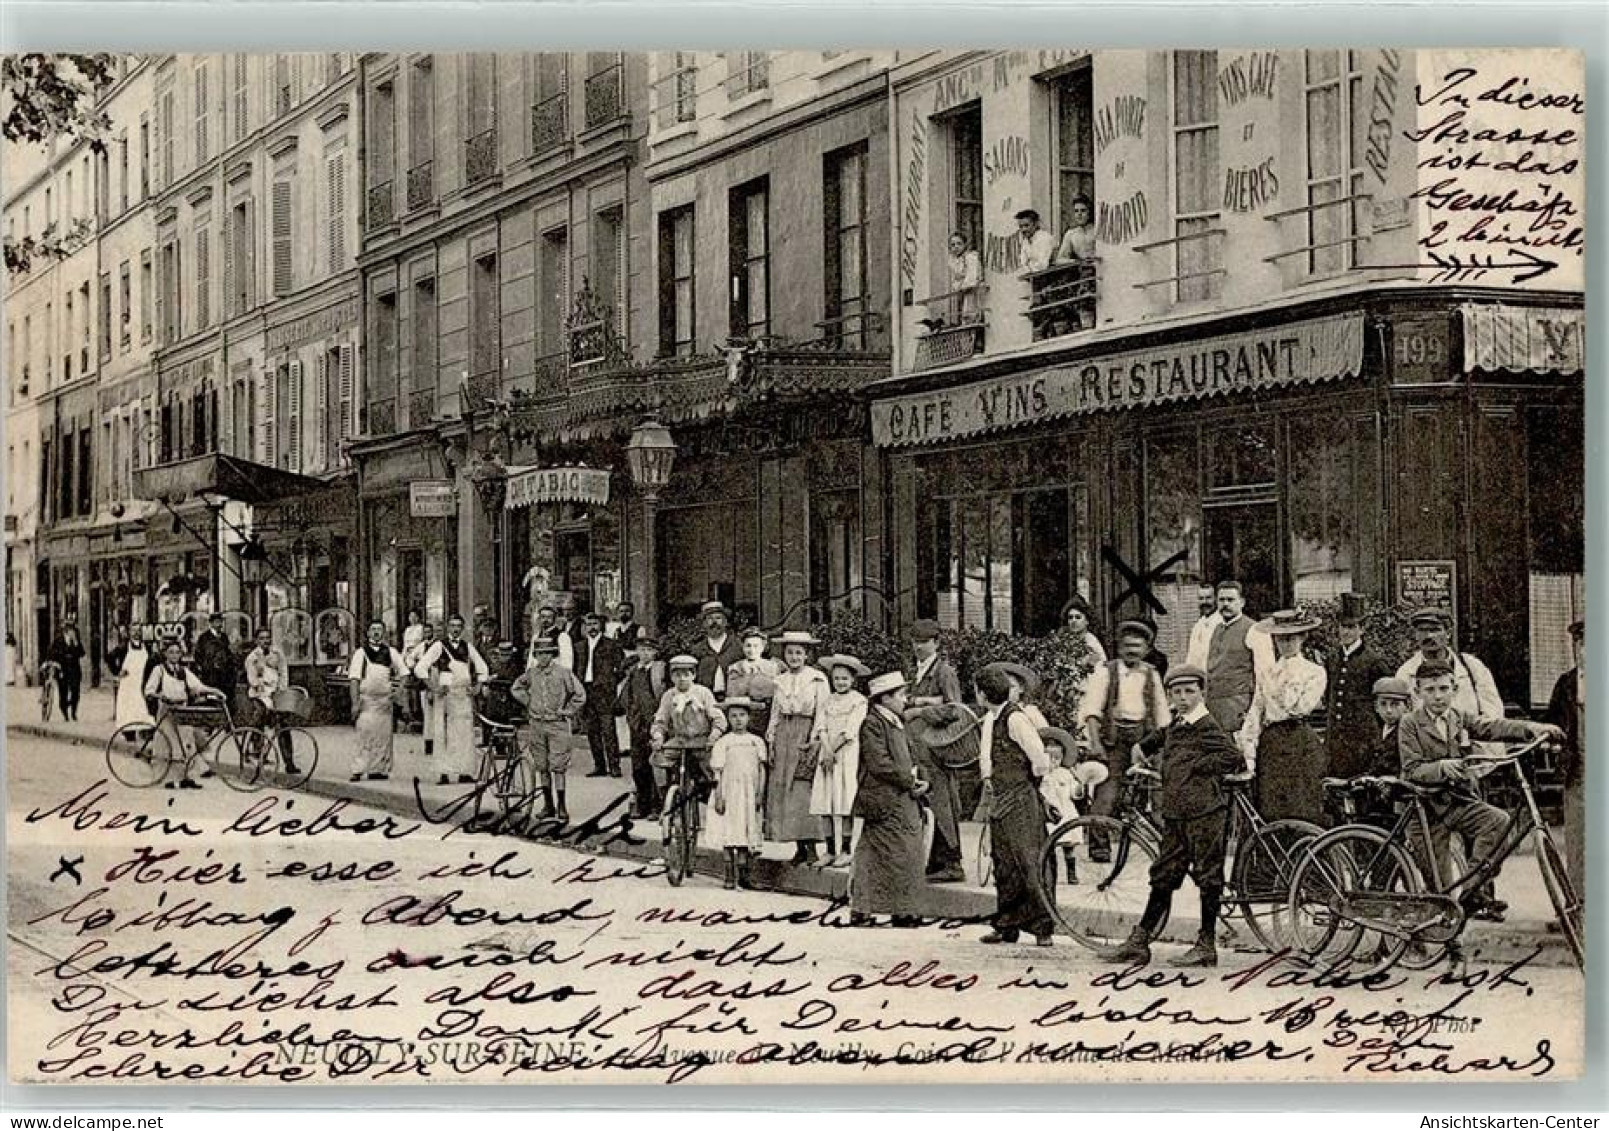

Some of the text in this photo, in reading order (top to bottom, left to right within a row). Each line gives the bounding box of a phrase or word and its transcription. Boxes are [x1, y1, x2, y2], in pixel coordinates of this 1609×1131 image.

[1219, 56, 1248, 105] VINS
[1477, 77, 1584, 113] dieser
[1402, 111, 1577, 144] Strasse
[984, 136, 1029, 186] SALONS
[1417, 148, 1578, 174] ist das
[1098, 190, 1147, 245] MADRID
[1418, 221, 1448, 247] 2
[979, 379, 1048, 425] VINS
[1078, 338, 1299, 404] RESTAURANT
[526, 472, 579, 497] TABAC
[25, 779, 203, 835] Mein
[222, 797, 422, 840] lieber
[105, 846, 672, 884] Hier esse ich zu
[366, 940, 583, 976] auch
[637, 969, 811, 1000] dass
[827, 961, 979, 992] alles
[997, 966, 1069, 991] in
[1091, 962, 1209, 991] der
[46, 1009, 402, 1051] Herzlichen
